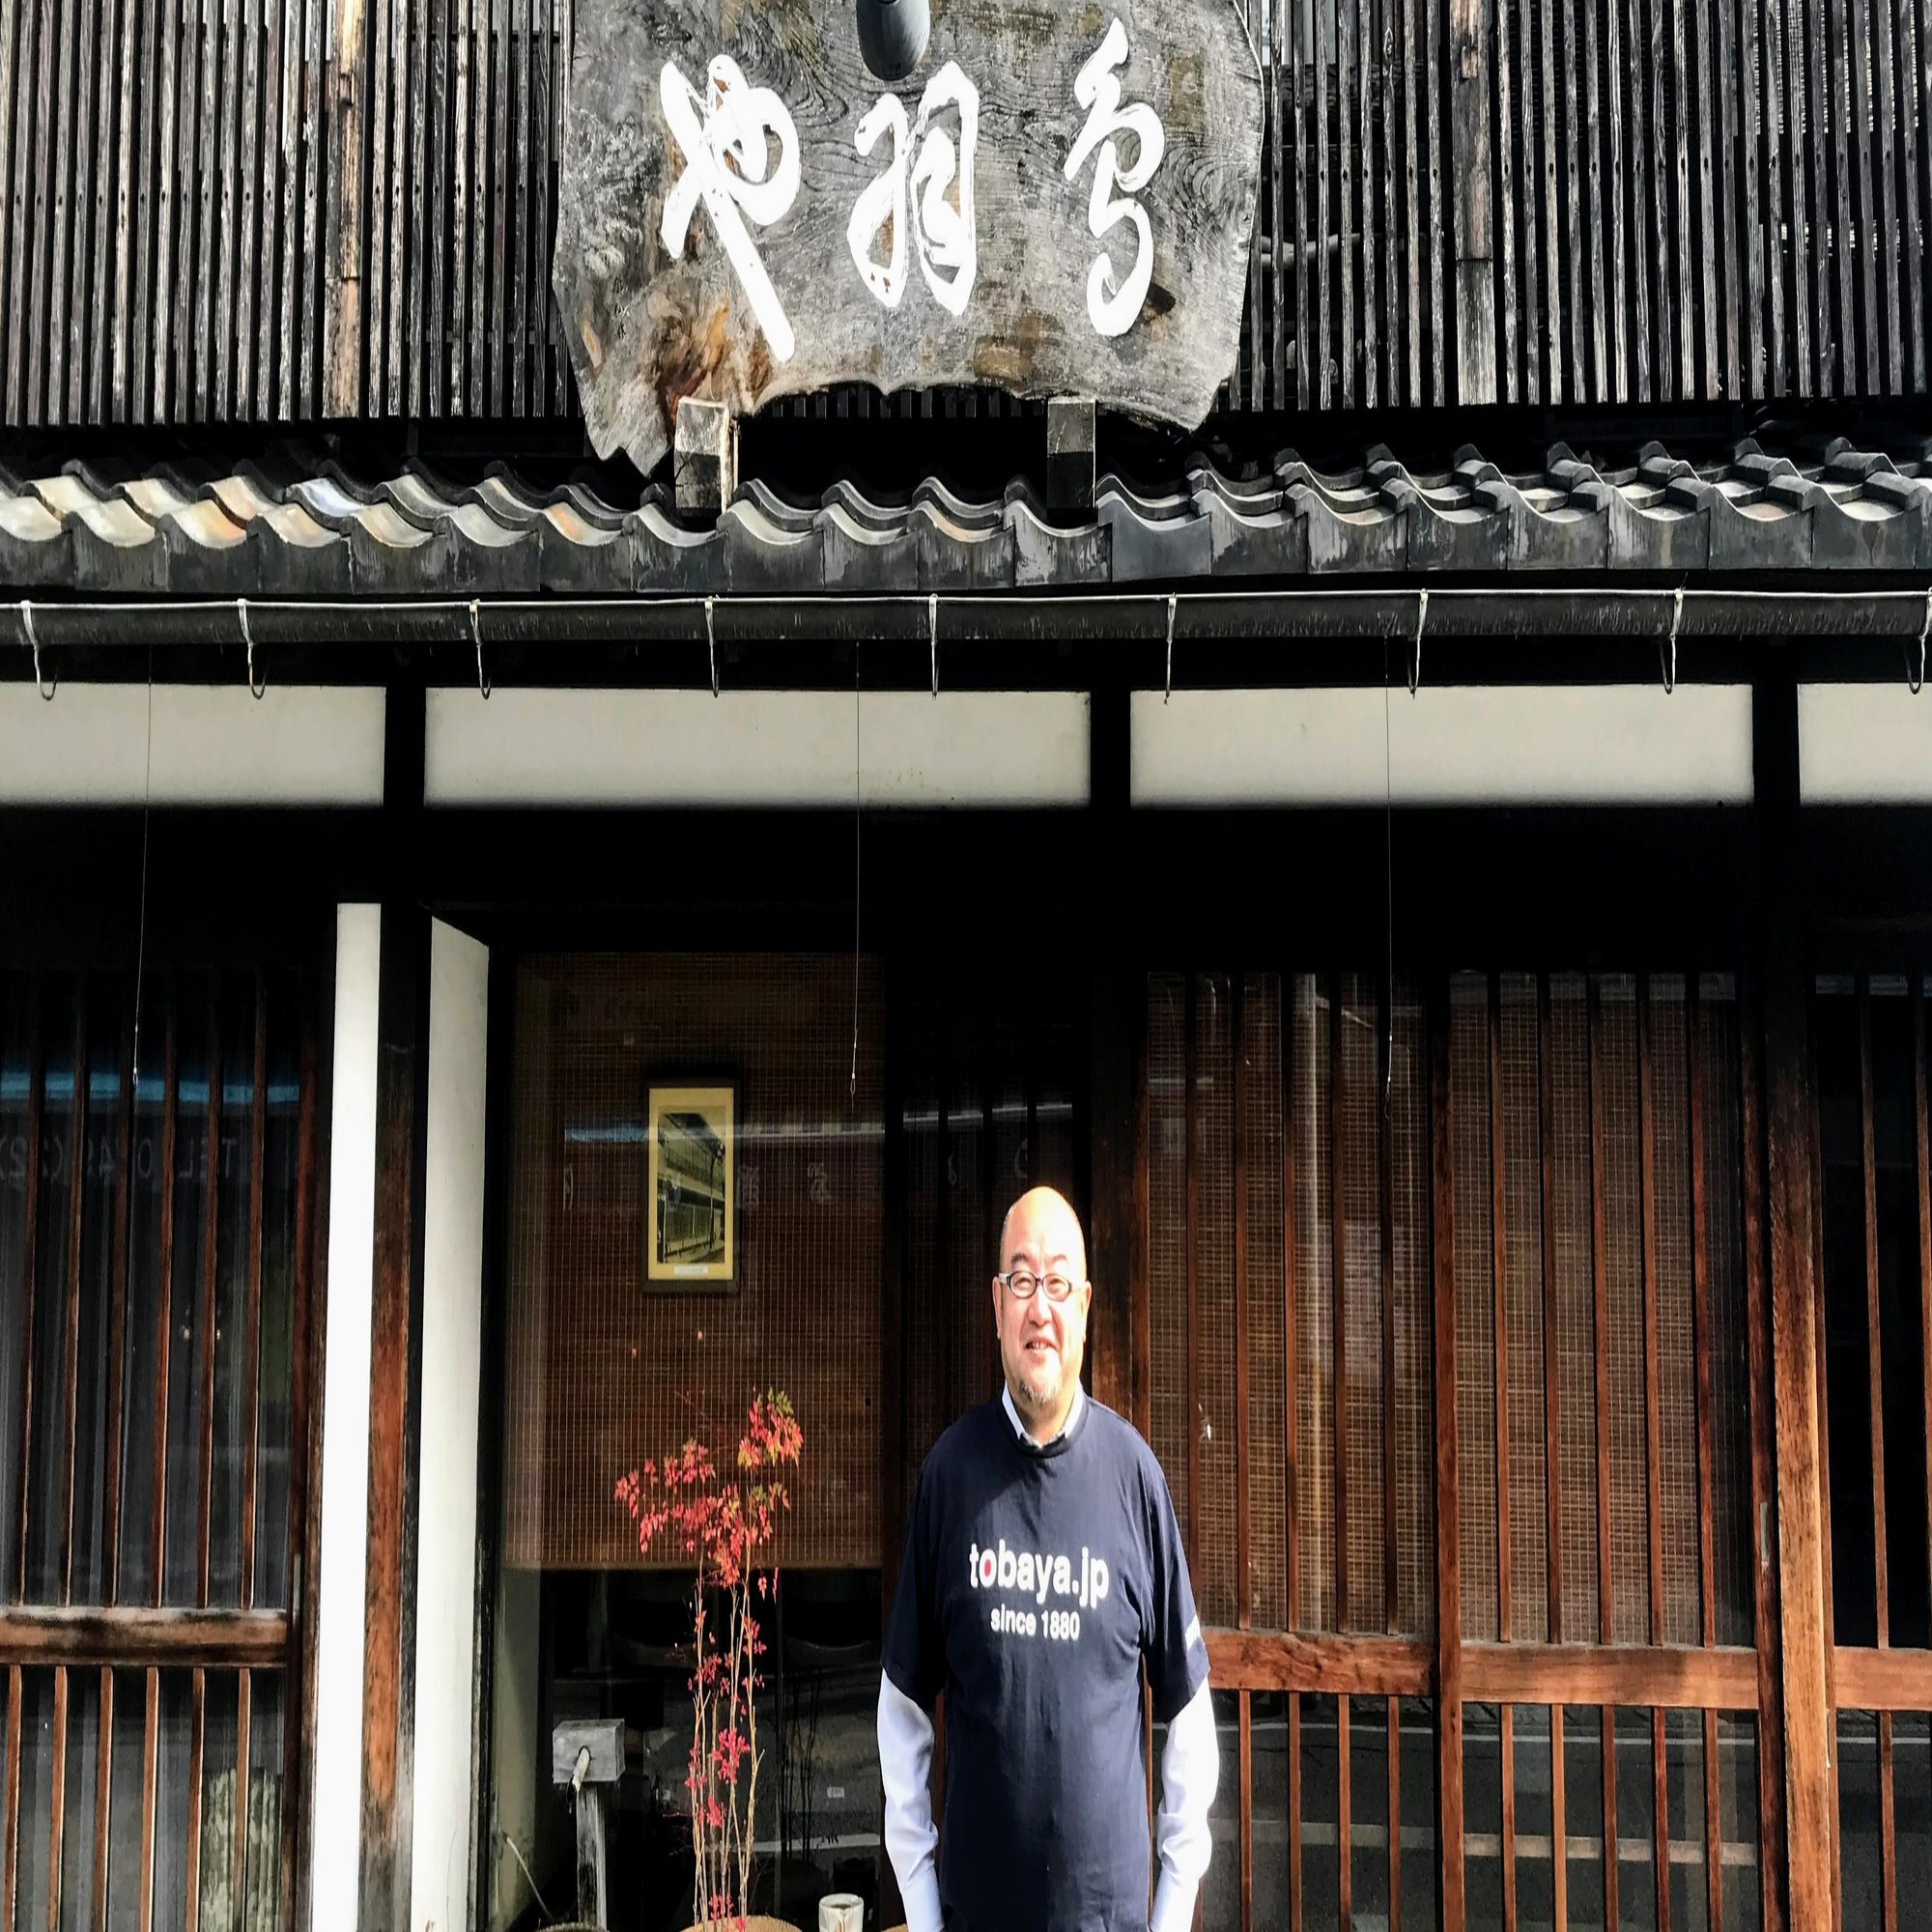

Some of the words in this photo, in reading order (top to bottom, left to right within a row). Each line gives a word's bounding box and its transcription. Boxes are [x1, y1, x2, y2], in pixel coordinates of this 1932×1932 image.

[969, 1538, 1109, 1609] tobaya.jp
[990, 1603, 1037, 1636] since
[1041, 1609, 1081, 1641] 1880
